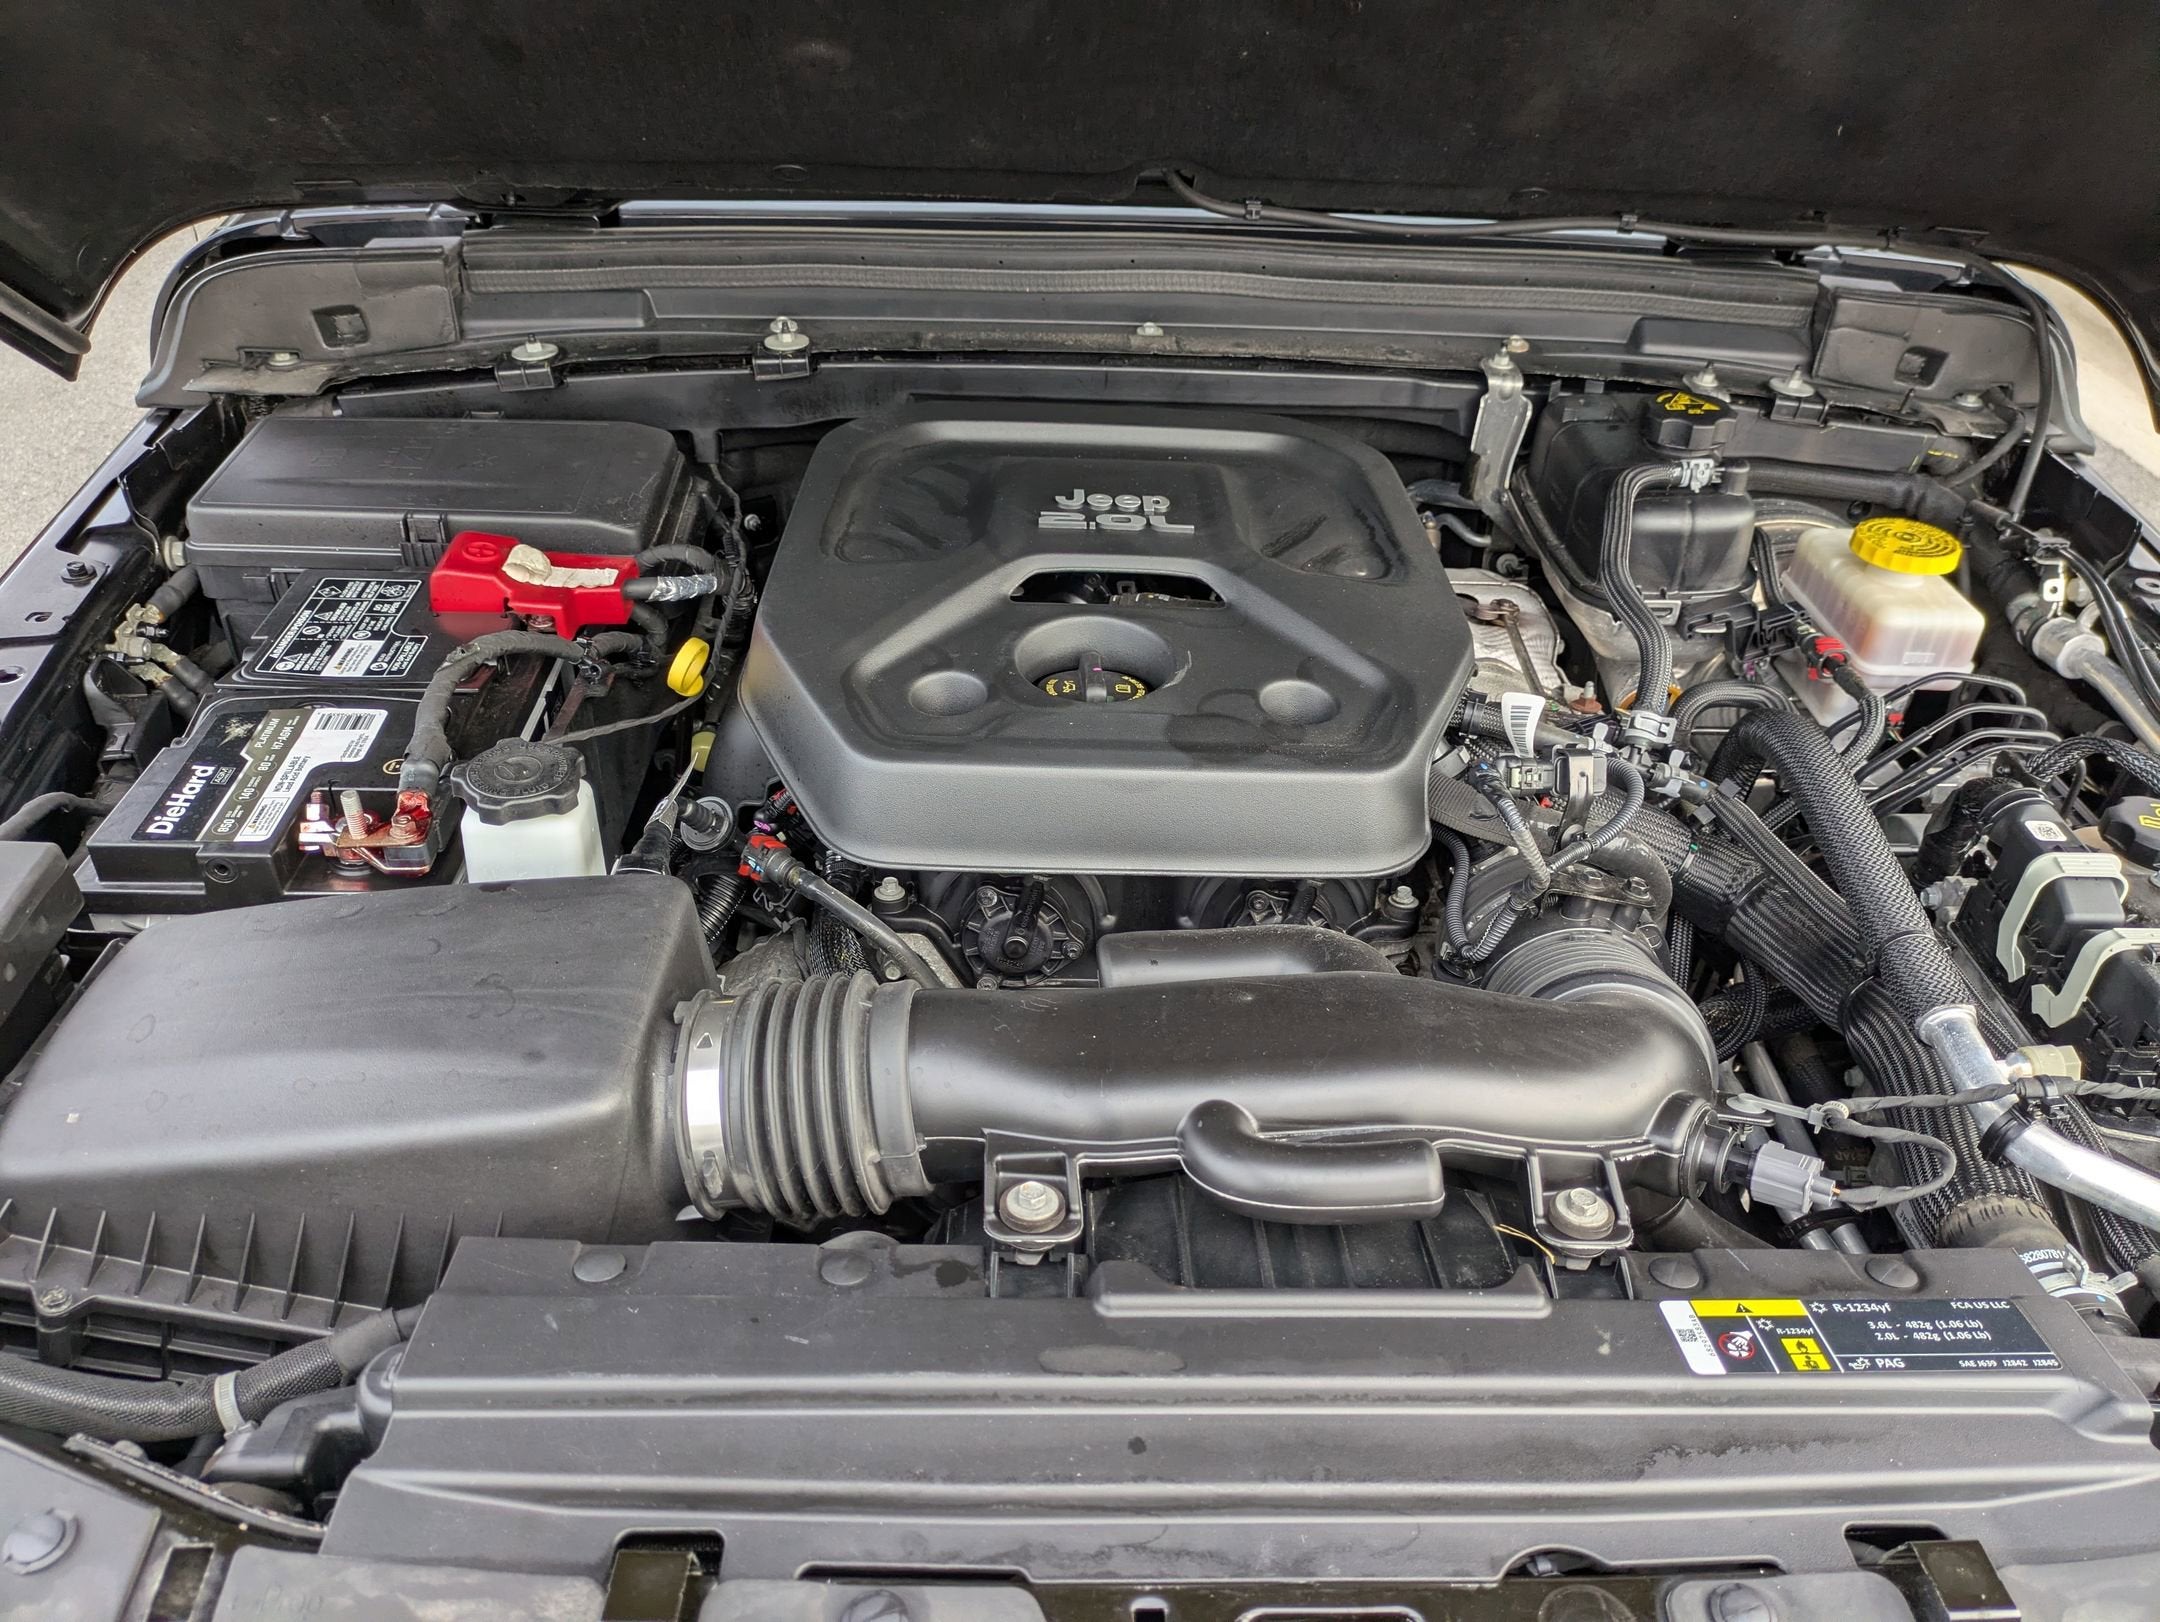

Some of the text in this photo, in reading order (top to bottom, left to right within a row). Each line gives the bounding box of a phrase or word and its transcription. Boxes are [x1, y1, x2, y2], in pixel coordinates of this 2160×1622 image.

[1055, 488, 1170, 515] Jeep
[1038, 511, 1195, 534] 2.0L
[254, 718, 281, 748] PLATINUM
[271, 726, 294, 750] H7-AGM
[257, 761, 272, 771] 80
[146, 764, 217, 835] DieHard
[238, 787, 255, 800] 140
[216, 819, 235, 834] 850
[1832, 1303, 1891, 1315] R-1234yf
[1951, 1301, 2010, 1310] FCA US LLC
[1776, 1327, 1814, 1336] R-1234yf
[1867, 1321, 1893, 1330] 3.6L
[1905, 1321, 1933, 1332] 482g
[1935, 1320, 1964, 1331] (1.06
[1965, 1320, 1984, 1330] Lb)
[1874, 1332, 1900, 1341] 2.0L
[1913, 1332, 1941, 1342] 482g
[1944, 1331, 1972, 1342] (1.06
[1973, 1331, 1992, 1341] Lb)
[1875, 1358, 1906, 1368] PAG
